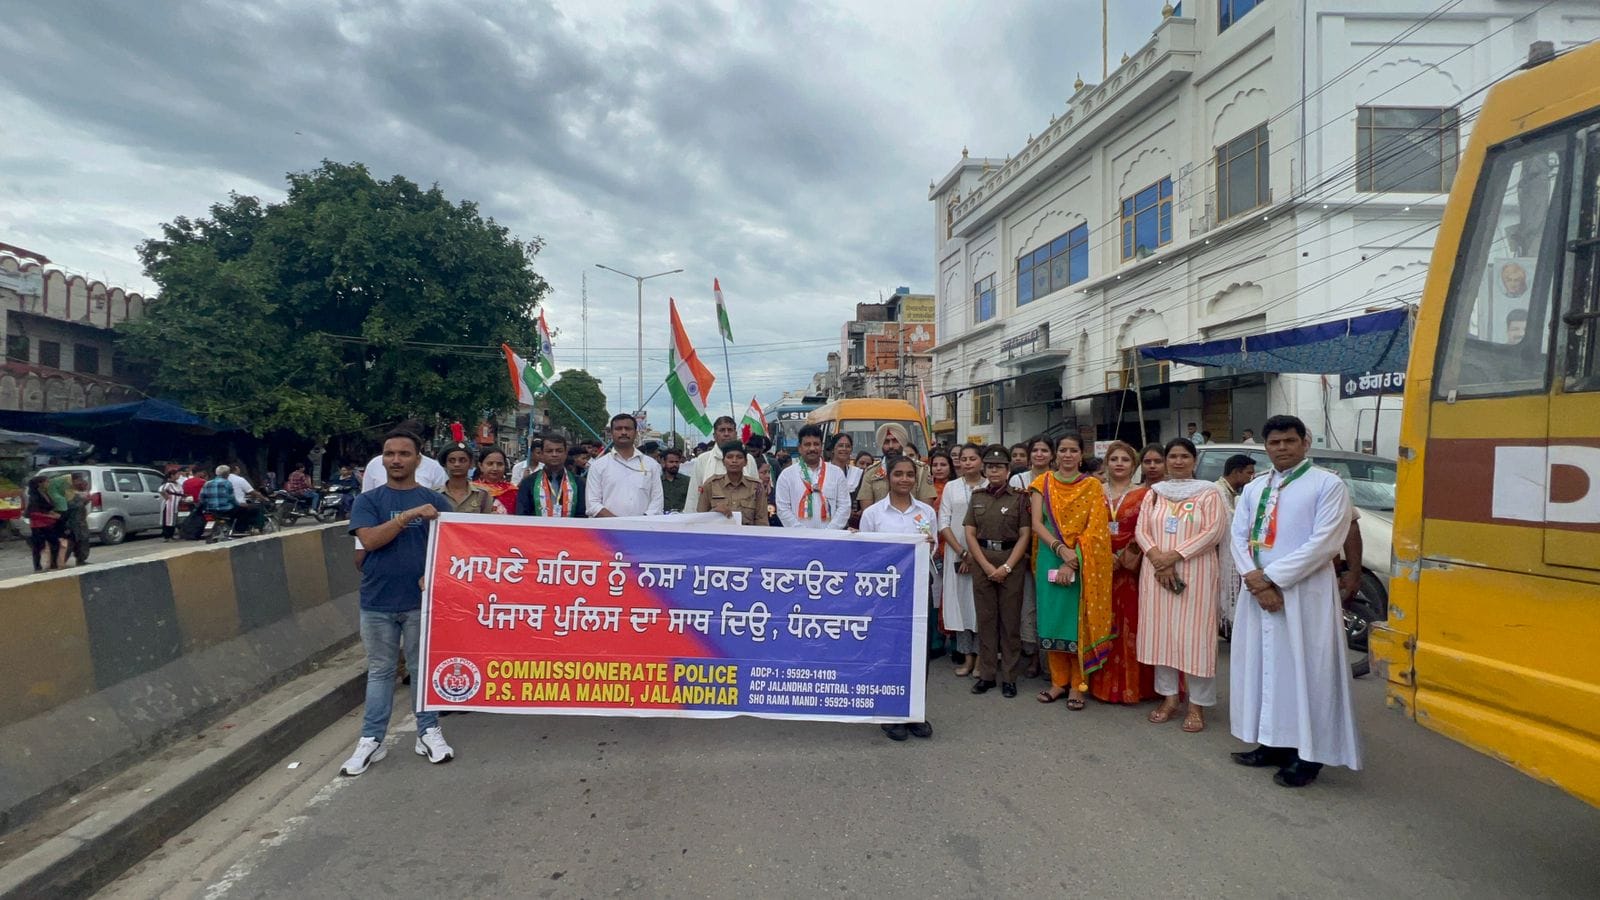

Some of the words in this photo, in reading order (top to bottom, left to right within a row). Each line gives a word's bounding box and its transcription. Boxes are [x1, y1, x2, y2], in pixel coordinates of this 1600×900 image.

[790, 411, 810, 420] SU
[449, 547, 529, 583] ਆਪਣੇ
[536, 550, 602, 586] ਸ਼ਹਿਰ
[608, 551, 632, 596] ਨੂੰ
[637, 562, 688, 589] ਨਸ਼ਾ
[693, 564, 754, 595] ਮੁਕਤ
[760, 559, 848, 600] ਬਣਾਉਣ
[854, 565, 901, 598] ਲਈ
[477, 593, 547, 630] ਪੰਜਾਬ
[553, 597, 623, 636] ਪੁਲਿਸ
[629, 607, 662, 633] ਦਾ
[667, 608, 714, 635] ਸਾਥ
[787, 603, 873, 641] ਧੰਨਵਾਦ
[486, 660, 668, 682] COMMISSIONERATE
[673, 664, 738, 684] POLICE
[750, 667, 779, 678] ADCP-1
[786, 668, 837, 680] 95929-14103
[485, 682, 516, 700] P.S.
[521, 682, 571, 701] RAMA
[576, 683, 635, 707] MANDI,
[640, 684, 739, 705] JALANDHAR
[749, 680, 766, 691] ACP
[767, 681, 813, 693] JALANDHAR
[814, 683, 850, 694] CENTRAL
[855, 684, 905, 696] 99154-00515
[748, 693, 765, 704] SHO
[766, 694, 790, 705] RAMA
[791, 695, 818, 707] MANDI
[824, 696, 875, 708] 95929-18586
